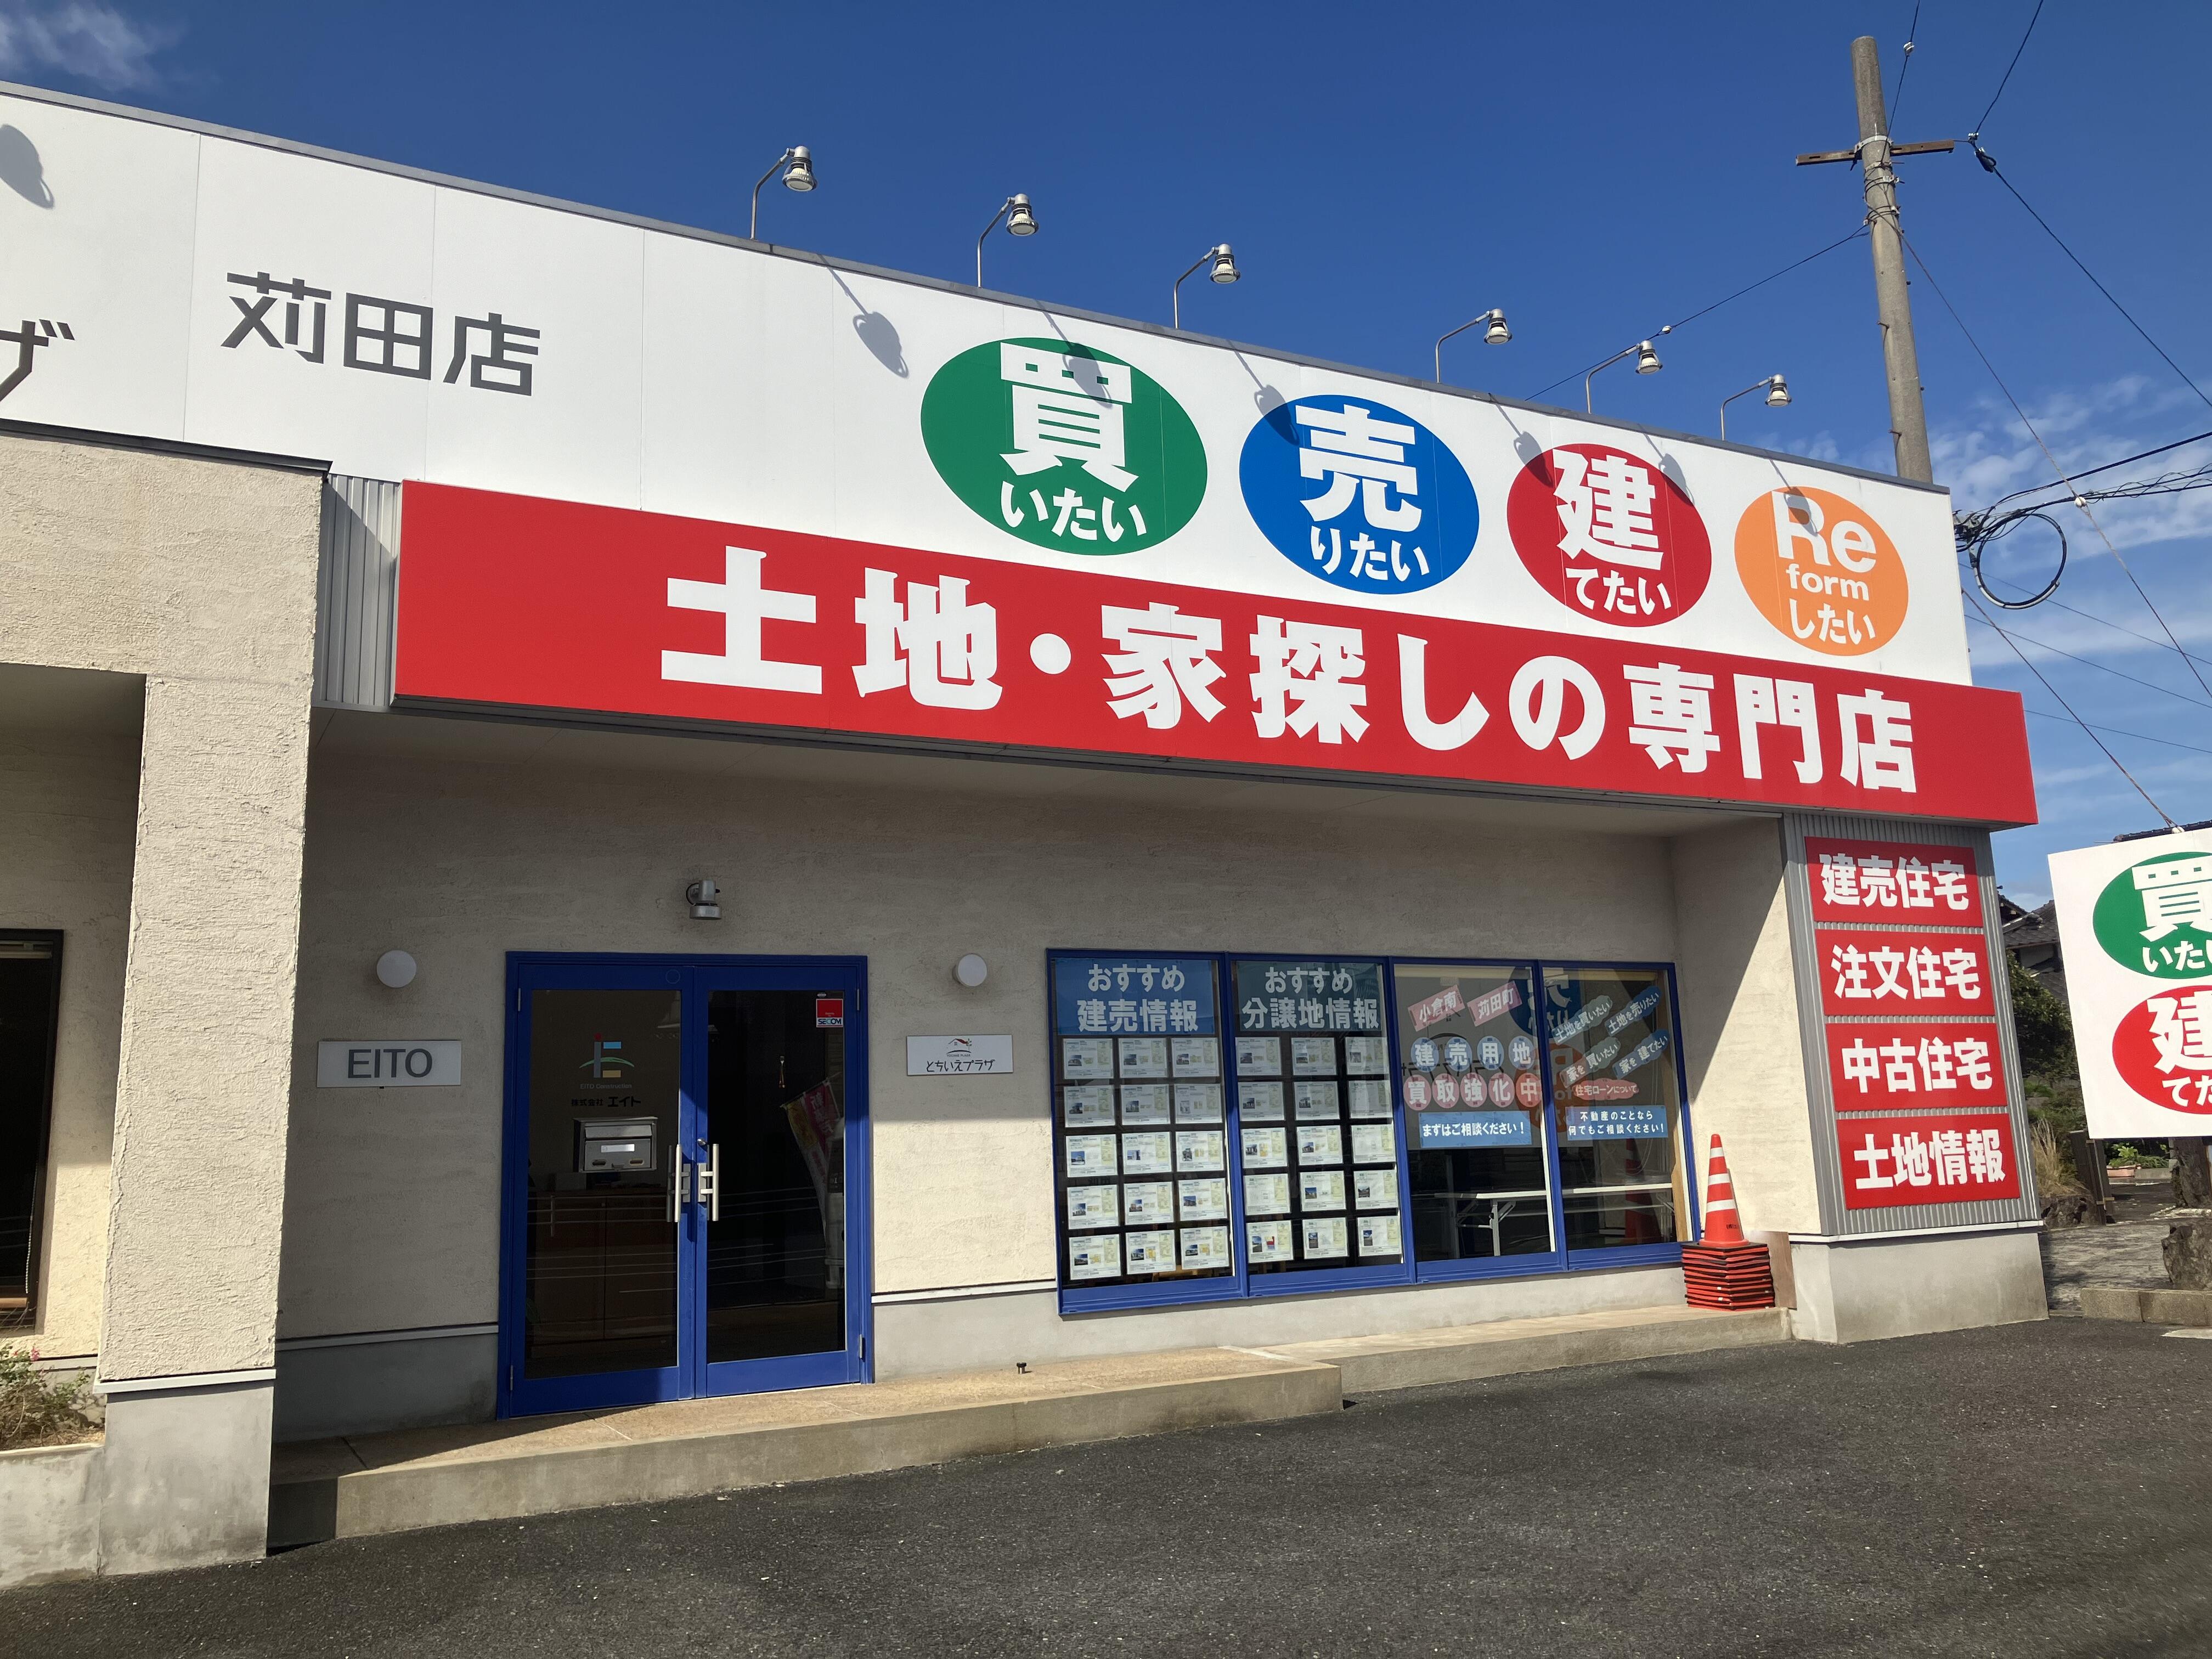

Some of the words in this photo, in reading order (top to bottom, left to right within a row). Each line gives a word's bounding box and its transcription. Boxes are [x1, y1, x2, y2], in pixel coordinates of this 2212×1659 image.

[221, 272, 540, 396] 苅田店
[1000, 342, 1139, 492] 買
[1295, 404, 1422, 533] 売
[1001, 481, 1147, 543] いたい
[1552, 449, 1663, 571] 建
[1771, 491, 1877, 573] Re
[1310, 526, 1429, 582] りたい
[1566, 568, 1672, 616] てたい
[1786, 563, 1870, 601] form
[1790, 598, 1876, 645] したい
[660, 545, 1917, 794] 土地・家探しの専門店
[1819, 853, 1970, 910] 建売住宅
[1087, 963, 1185, 992] おすすめ
[1264, 966, 1353, 994] おすすめ
[1830, 944, 1981, 1000] 注文住宅
[1076, 998, 1199, 1032] 建売情報
[1242, 997, 1379, 1030] 分譲地情報
[1419, 990, 1458, 1023] 小倉南
[1477, 988, 1515, 1019] 苅田町
[1555, 1002, 1610, 1043] 土地を買いたい
[1608, 992, 1660, 1035] 土地を売りたい
[348, 1048, 432, 1078] EITO
[926, 1059, 996, 1073] とちいえプラザ
[1842, 1036, 1993, 1093] 中古住宅
[607, 1096, 641, 1107] エイト
[1576, 1085, 1638, 1096] 住宅ローンについて
[1580, 1110, 1653, 1122] 不動産のことなら
[1854, 1129, 2006, 1189] 土地情報
